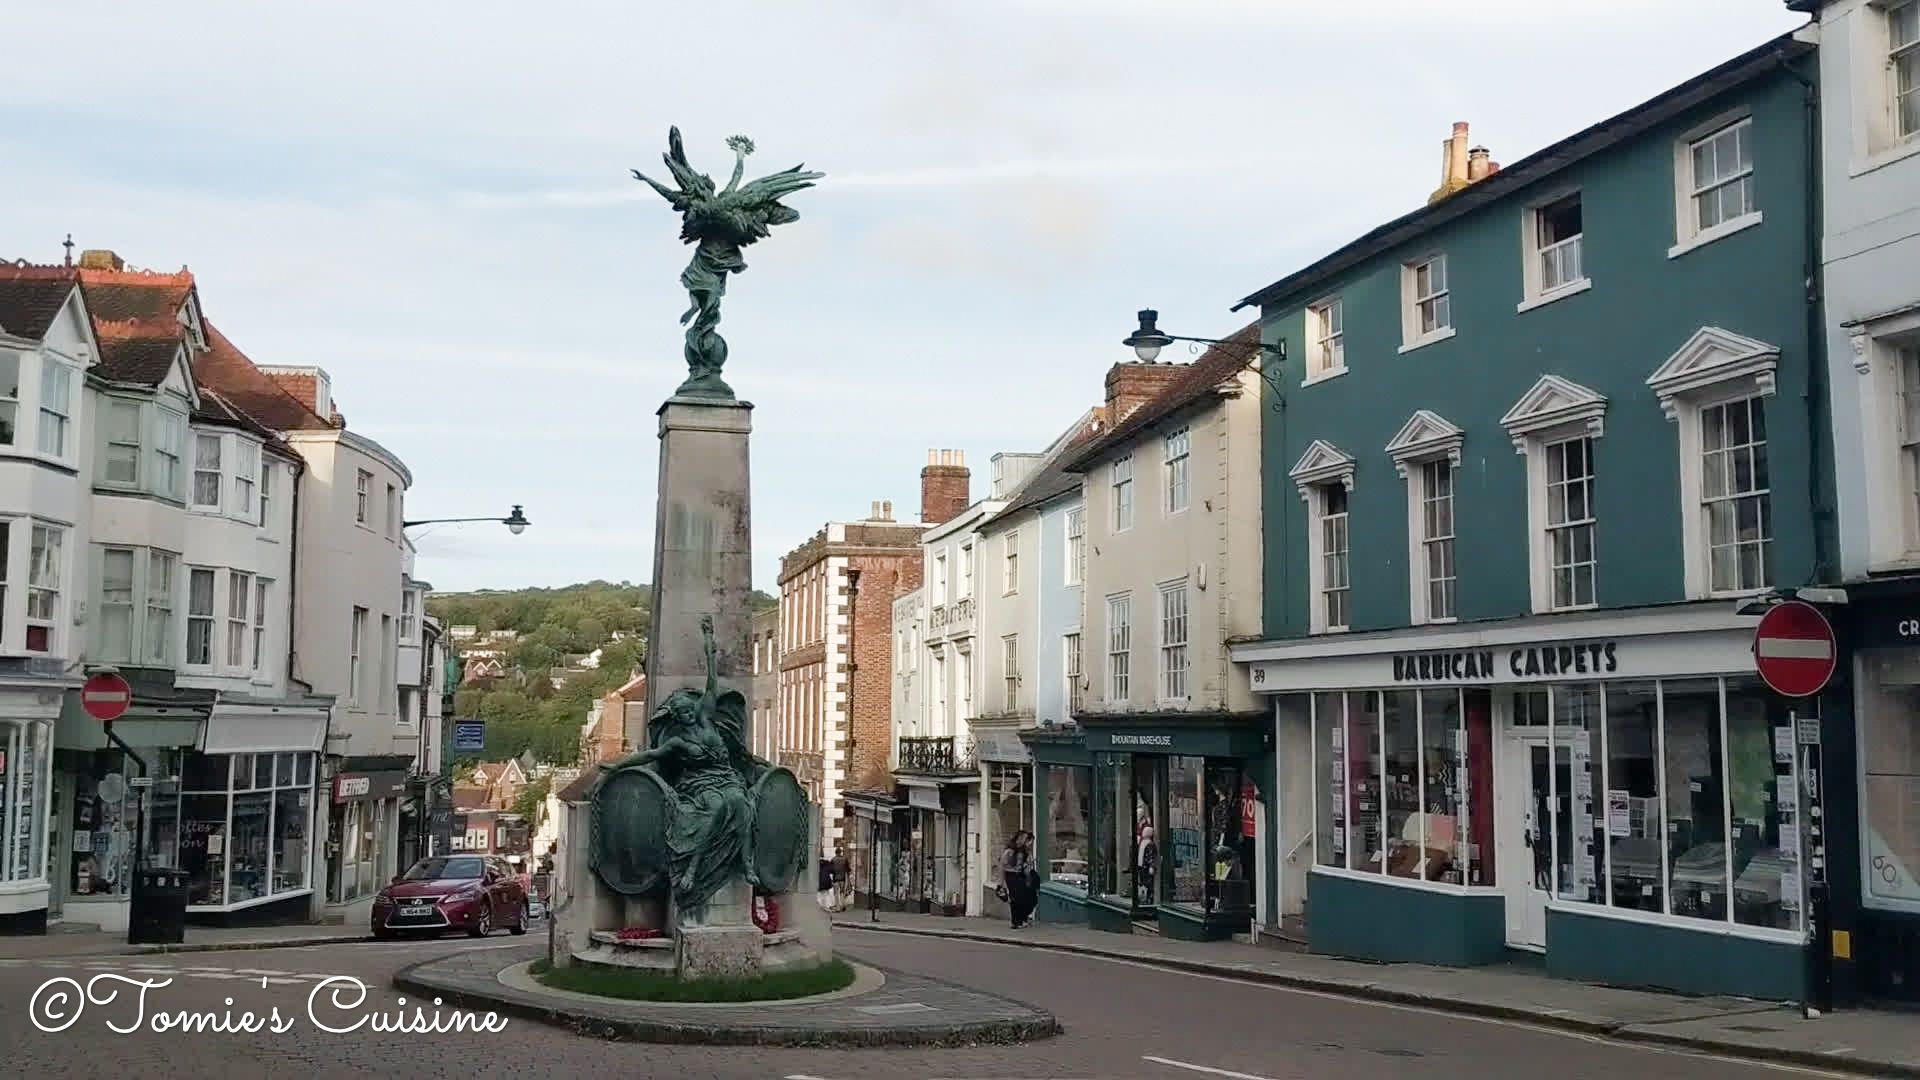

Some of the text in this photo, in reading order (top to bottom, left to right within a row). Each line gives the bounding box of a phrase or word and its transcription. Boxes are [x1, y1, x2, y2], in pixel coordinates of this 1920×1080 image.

[1392, 642, 1617, 681] BARBICAN CARPETS
[1254, 669, 1265, 684] 39
[1115, 735, 1171, 745] MOUNTAIN WAREHOUSE
